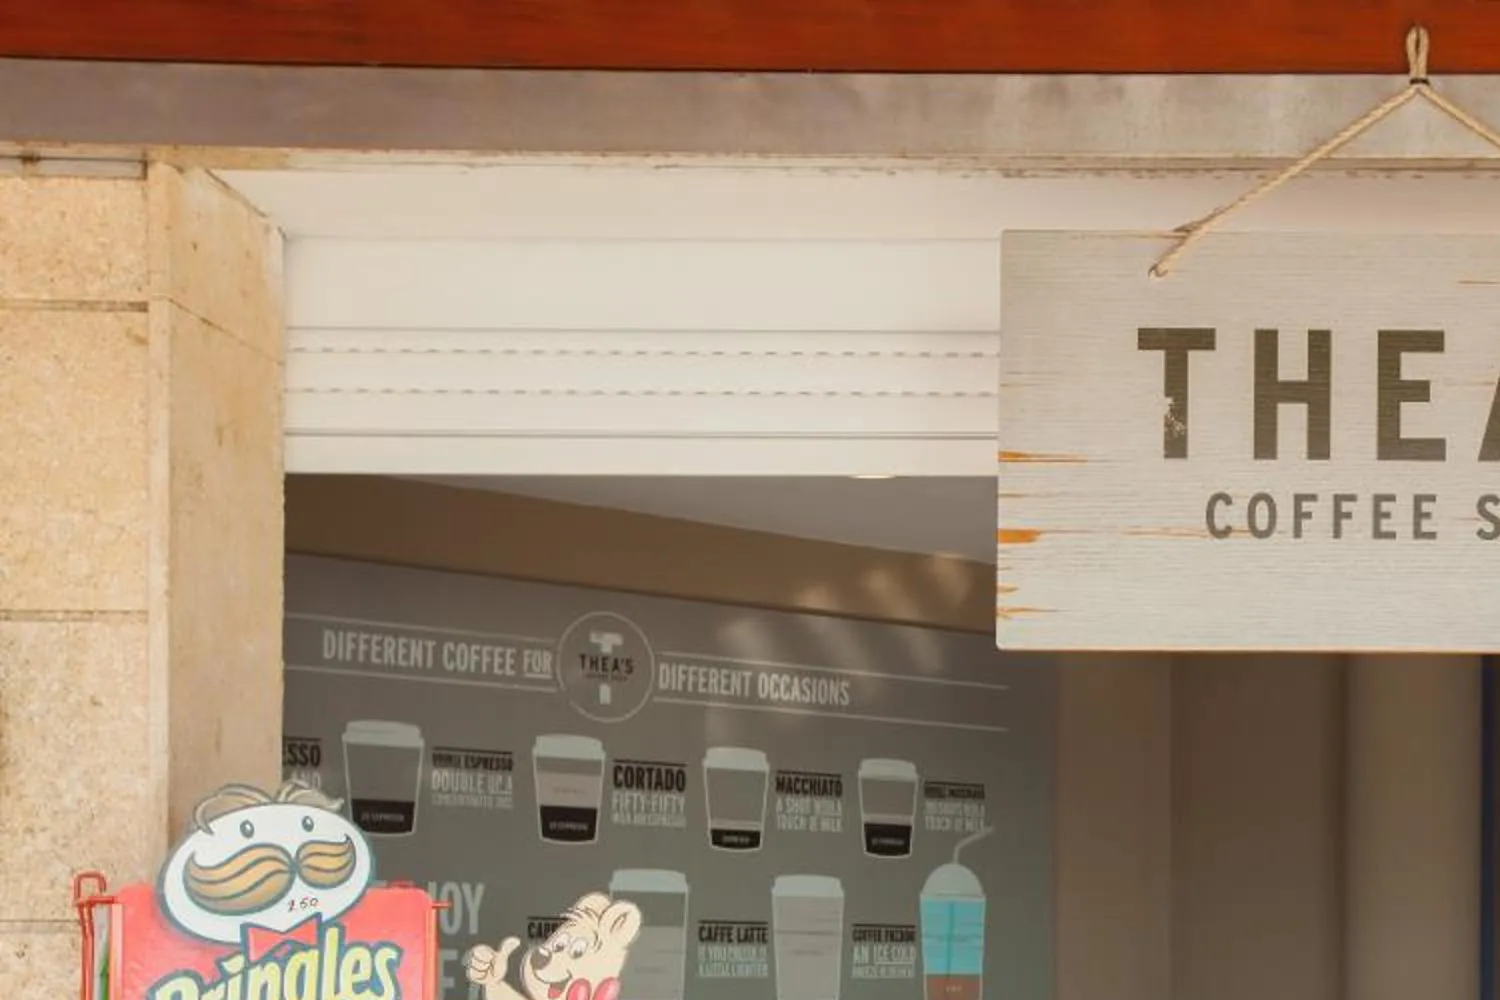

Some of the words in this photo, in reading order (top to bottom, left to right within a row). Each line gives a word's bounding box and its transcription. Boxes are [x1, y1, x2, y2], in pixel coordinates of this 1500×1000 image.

[1205, 491, 1439, 541] COFFEE
[323, 629, 438, 670] DIFFERENT
[442, 641, 517, 676] COFFEE
[523, 648, 552, 674] FOR
[578, 653, 635, 675] THEA'S
[658, 662, 753, 697] DIFFERENT
[757, 672, 850, 706] OCCASIONS
[613, 765, 686, 792] CORTADO
[775, 776, 843, 798] MACCHIATO
[737, 926, 768, 944] LATTE
